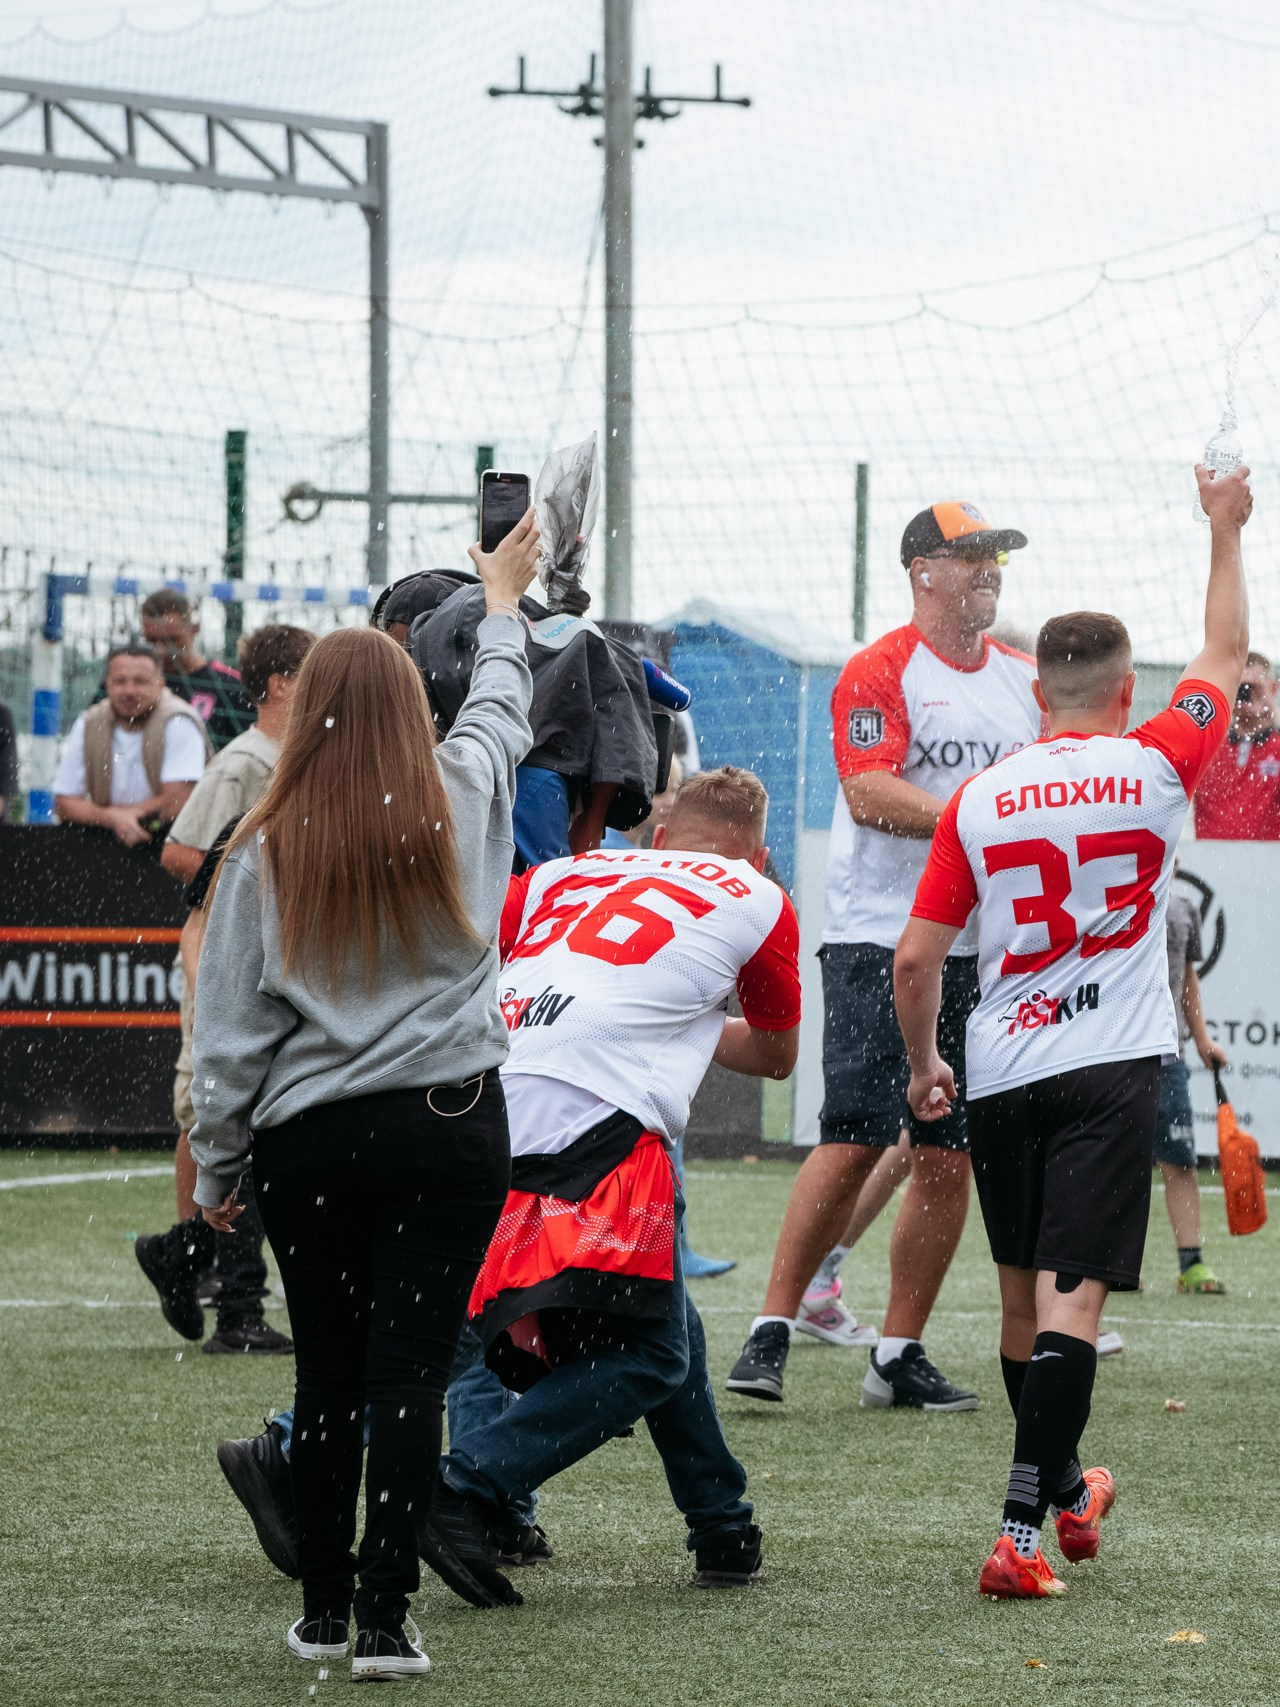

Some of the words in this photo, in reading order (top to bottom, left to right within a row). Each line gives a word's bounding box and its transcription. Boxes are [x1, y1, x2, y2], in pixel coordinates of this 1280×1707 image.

[852, 717, 880, 743] EML
[995, 776, 1142, 820] БЛОХИН
[506, 872, 718, 967] 66
[982, 828, 1167, 978] 33
